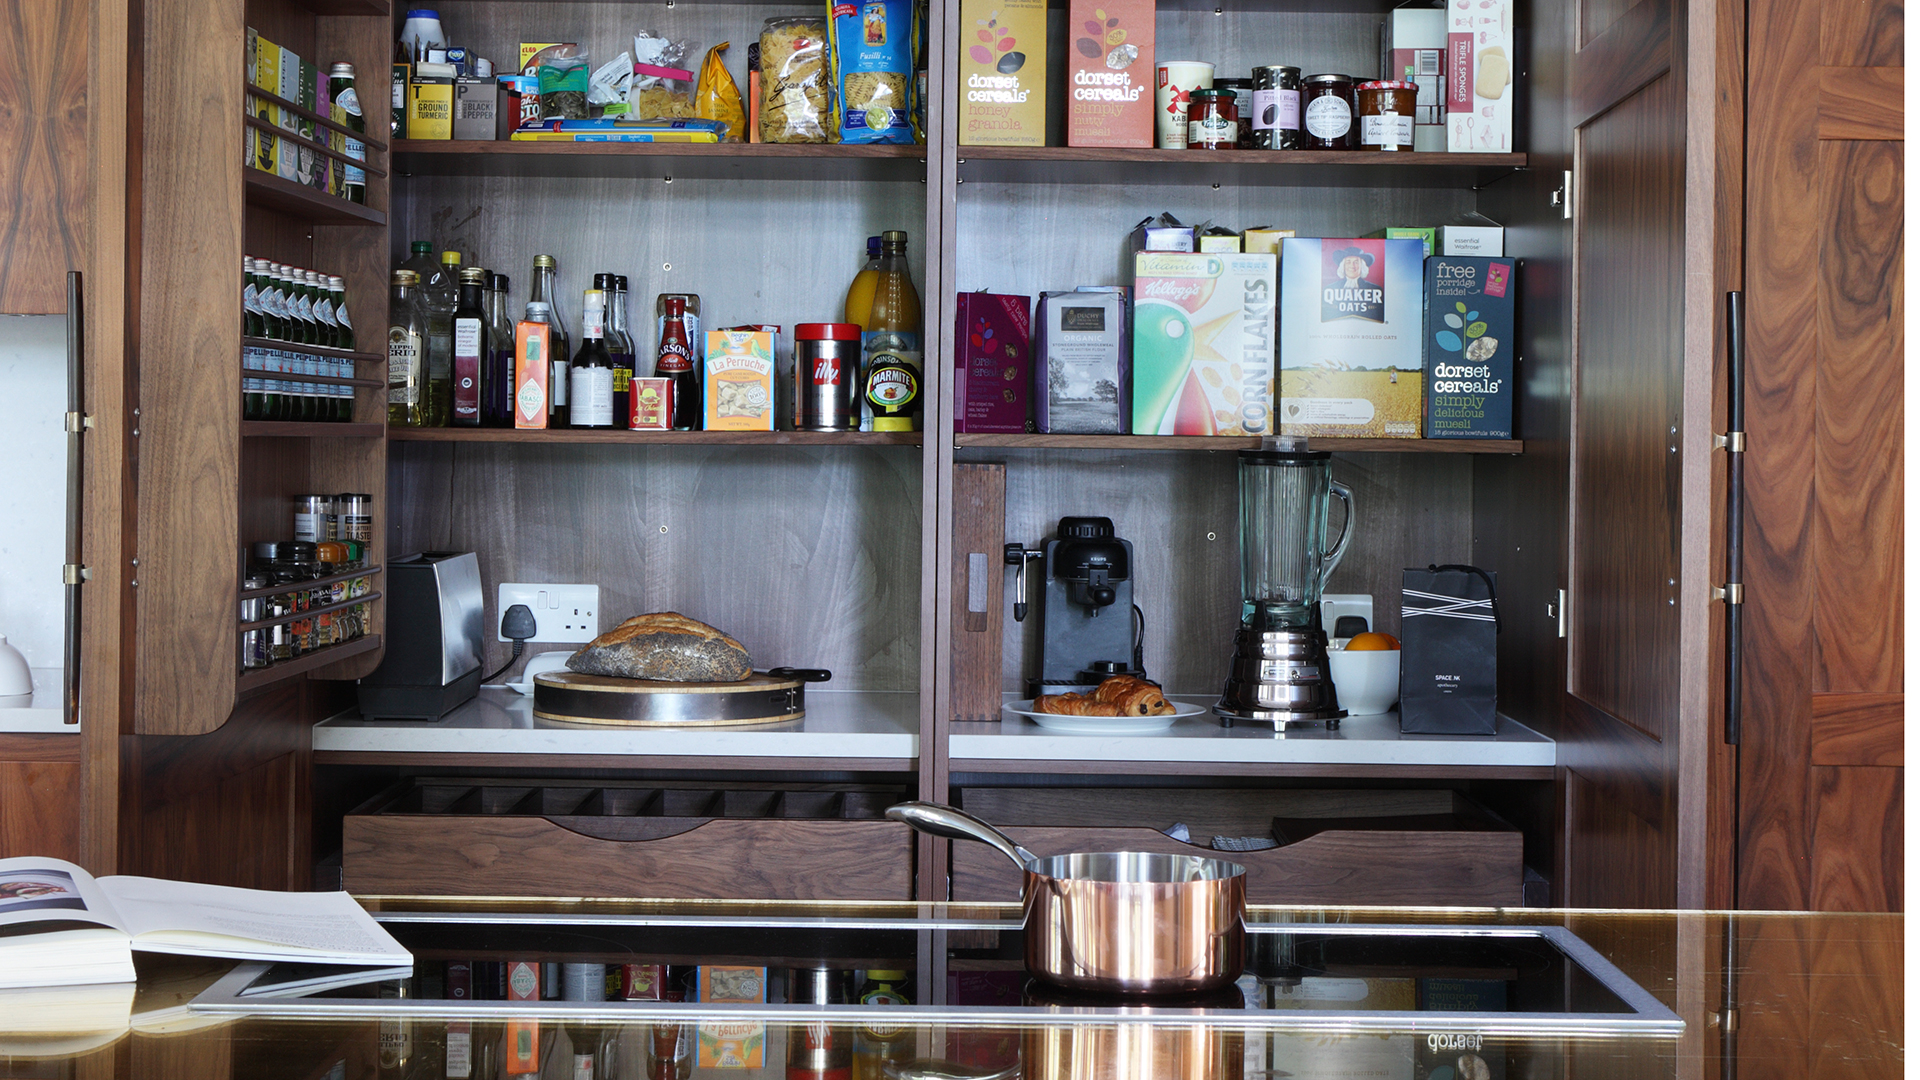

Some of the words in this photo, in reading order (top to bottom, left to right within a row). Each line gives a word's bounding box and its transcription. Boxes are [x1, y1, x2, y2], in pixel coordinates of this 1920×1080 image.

[1459, 40, 1467, 66] TRIFLE
[967, 73, 1020, 89] dorset
[1074, 69, 1131, 86] dorset
[1459, 66, 1467, 103] SPONGES
[413, 86, 422, 99] T
[458, 86, 468, 99] P
[967, 89, 1027, 103] cereals
[1074, 86, 1140, 102] cereals
[418, 103, 449, 112] GROUND
[968, 103, 1012, 118] honey
[1074, 102, 1124, 118] simply
[418, 112, 449, 120] TURMERIC
[467, 112, 493, 120] PEPPER
[1074, 117, 1104, 127] nutty
[968, 118, 1022, 132] granola
[1074, 127, 1111, 137] muesli
[1141, 257, 1205, 271] Vitamin
[1207, 258, 1220, 275] D
[1436, 261, 1476, 279] free
[1145, 279, 1201, 300] Kellogg's
[1436, 278, 1476, 289] porridge
[1323, 288, 1383, 305] QUAKER
[1436, 288, 1467, 296] inside!
[1010, 298, 1017, 307] 6
[1015, 304, 1028, 327] bars
[1338, 302, 1368, 313] OATS
[1243, 278, 1270, 363] FLAKES
[1063, 334, 1103, 342] ORGANIC
[389, 349, 416, 357] ERIO
[712, 360, 725, 371] La
[726, 357, 766, 372] Perruche
[814, 360, 839, 383] illy
[1434, 362, 1491, 379] dorset
[872, 369, 910, 386] MARMITE
[1434, 378, 1499, 394] cereals
[1241, 366, 1268, 434] CORN
[1434, 394, 1486, 410] simply
[1434, 407, 1485, 418] delicious
[1434, 419, 1471, 429] muesli
